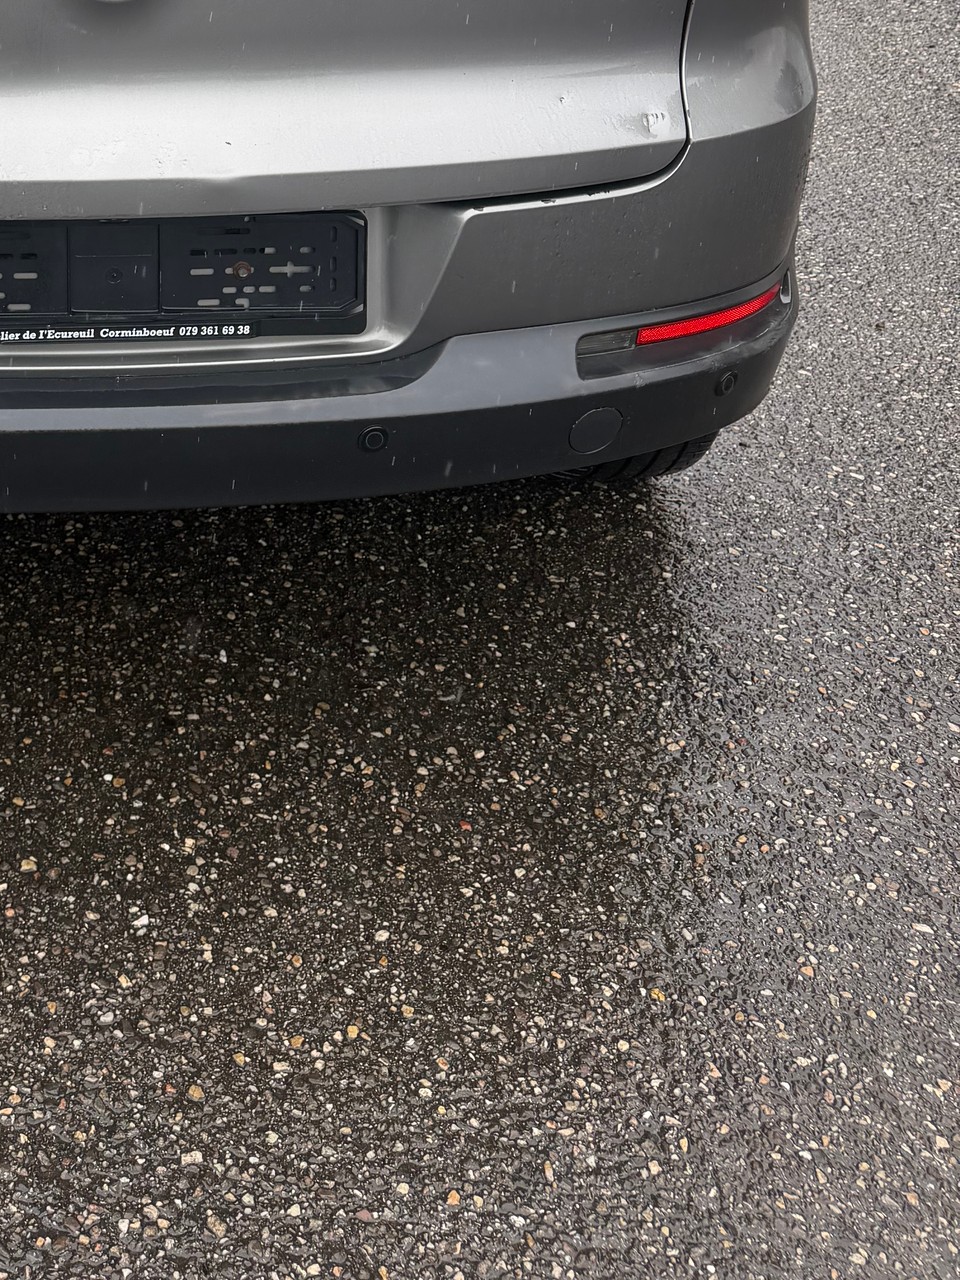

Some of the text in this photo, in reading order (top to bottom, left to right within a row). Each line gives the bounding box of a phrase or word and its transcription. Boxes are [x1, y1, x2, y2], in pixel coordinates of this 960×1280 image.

[22, 330, 37, 340] de
[99, 326, 176, 338] Corminboeuf
[178, 326, 199, 337] 079
[200, 325, 219, 336] 361
[222, 325, 235, 336] 69
[237, 324, 251, 335] 38
